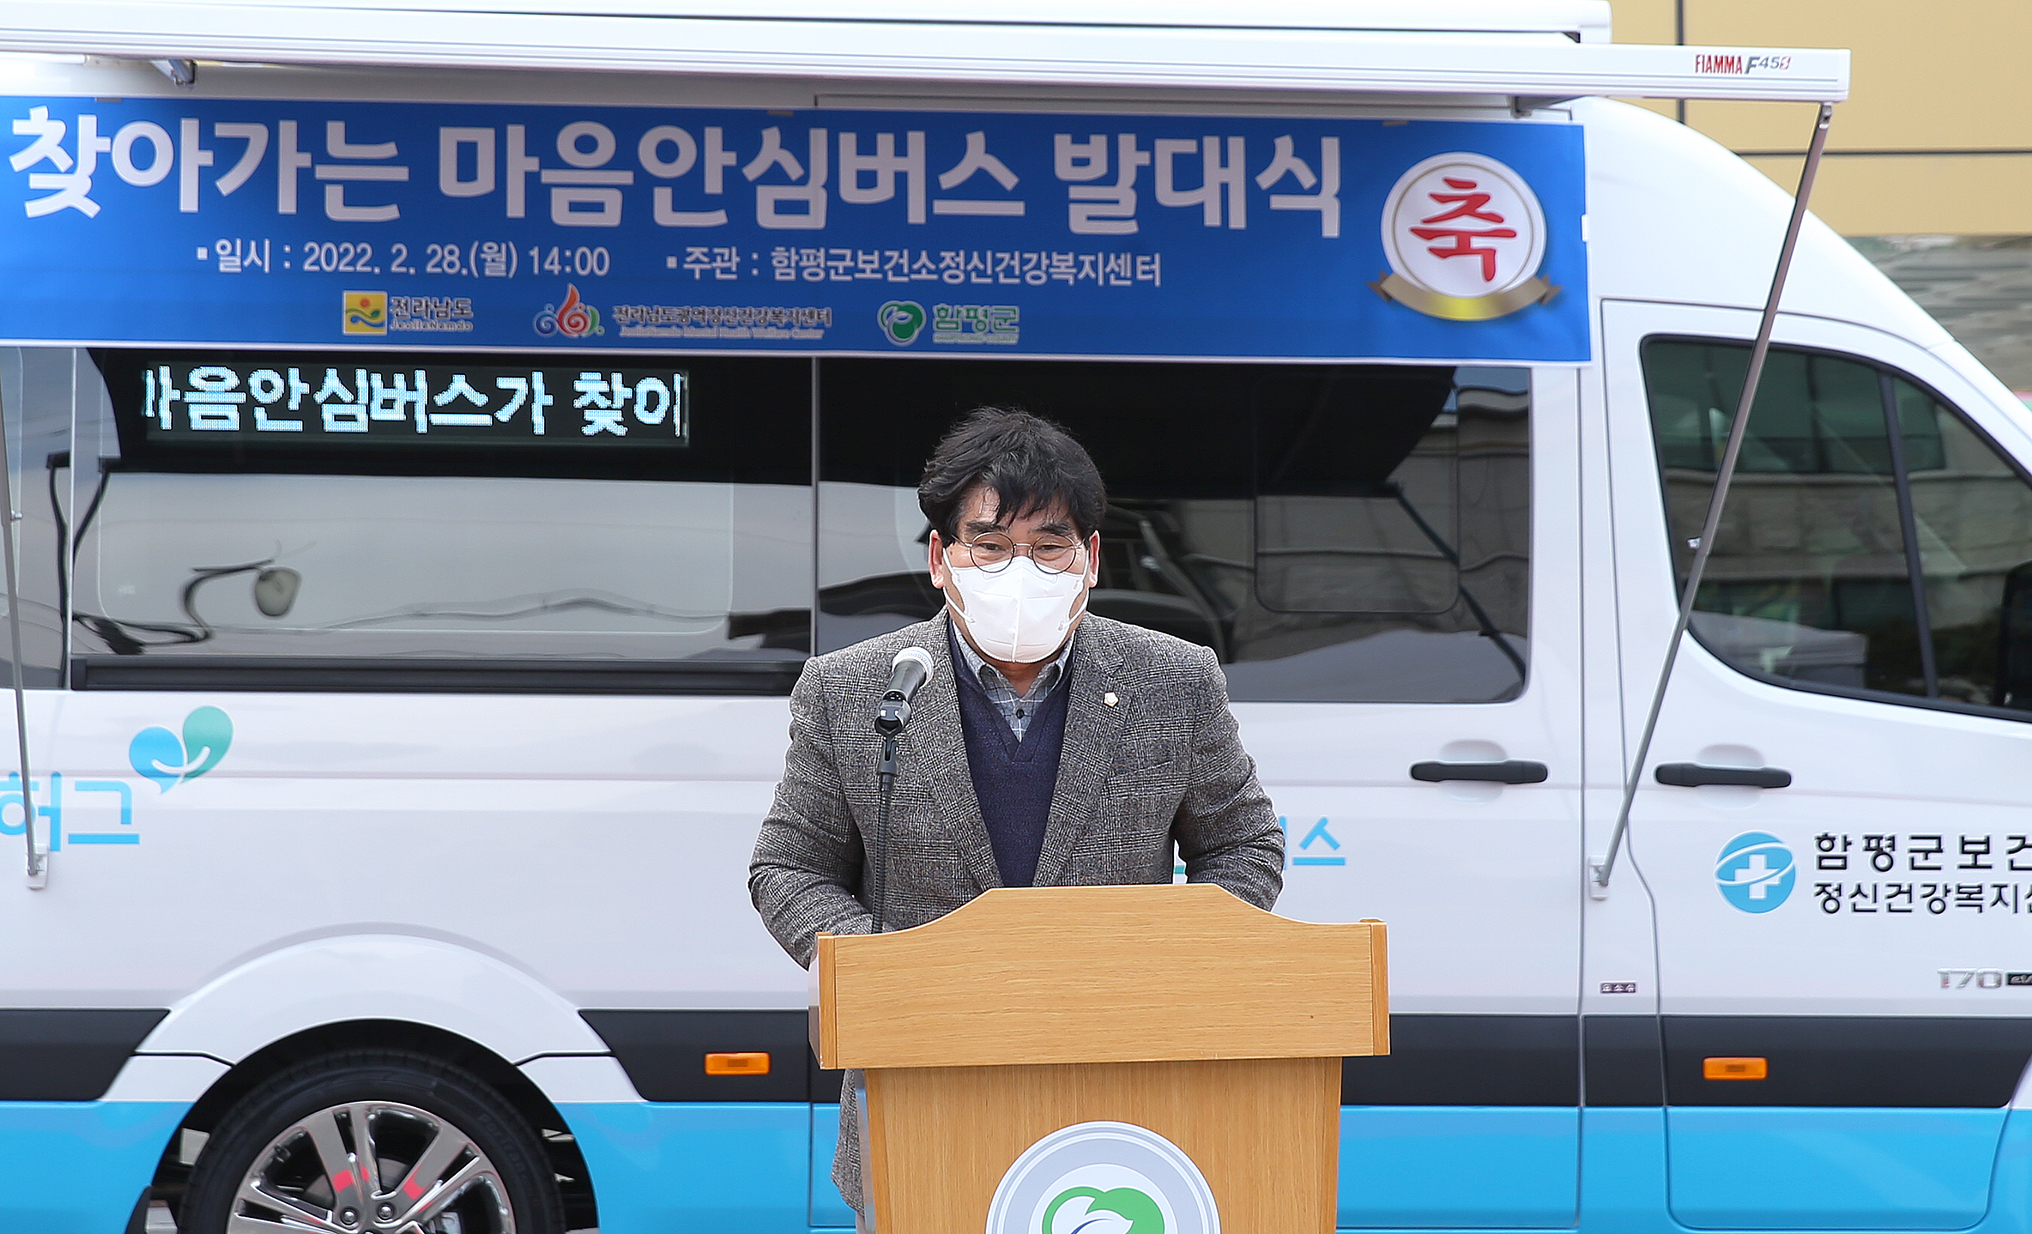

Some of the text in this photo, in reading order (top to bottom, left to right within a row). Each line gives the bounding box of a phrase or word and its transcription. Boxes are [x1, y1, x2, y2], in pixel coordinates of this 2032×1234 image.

[1694, 54, 1743, 74] FIAMMA
[9, 105, 1341, 239] 찾아가는 마음안심버스 발대식
[1409, 176, 1517, 283] 축
[214, 238, 271, 274] 일시
[302, 240, 381, 275] 2022.
[390, 242, 417, 275] 2.
[425, 240, 519, 279] 28.(월)
[528, 246, 611, 276] 14:00
[682, 246, 741, 281] 주관
[770, 246, 1163, 288] 함평군보건소정신건강복지센터
[390, 296, 474, 321] 전라남도
[933, 303, 1020, 334] 함평군
[1279, 815, 1346, 871] 스
[1813, 882, 2032, 915] 정신건강복지
